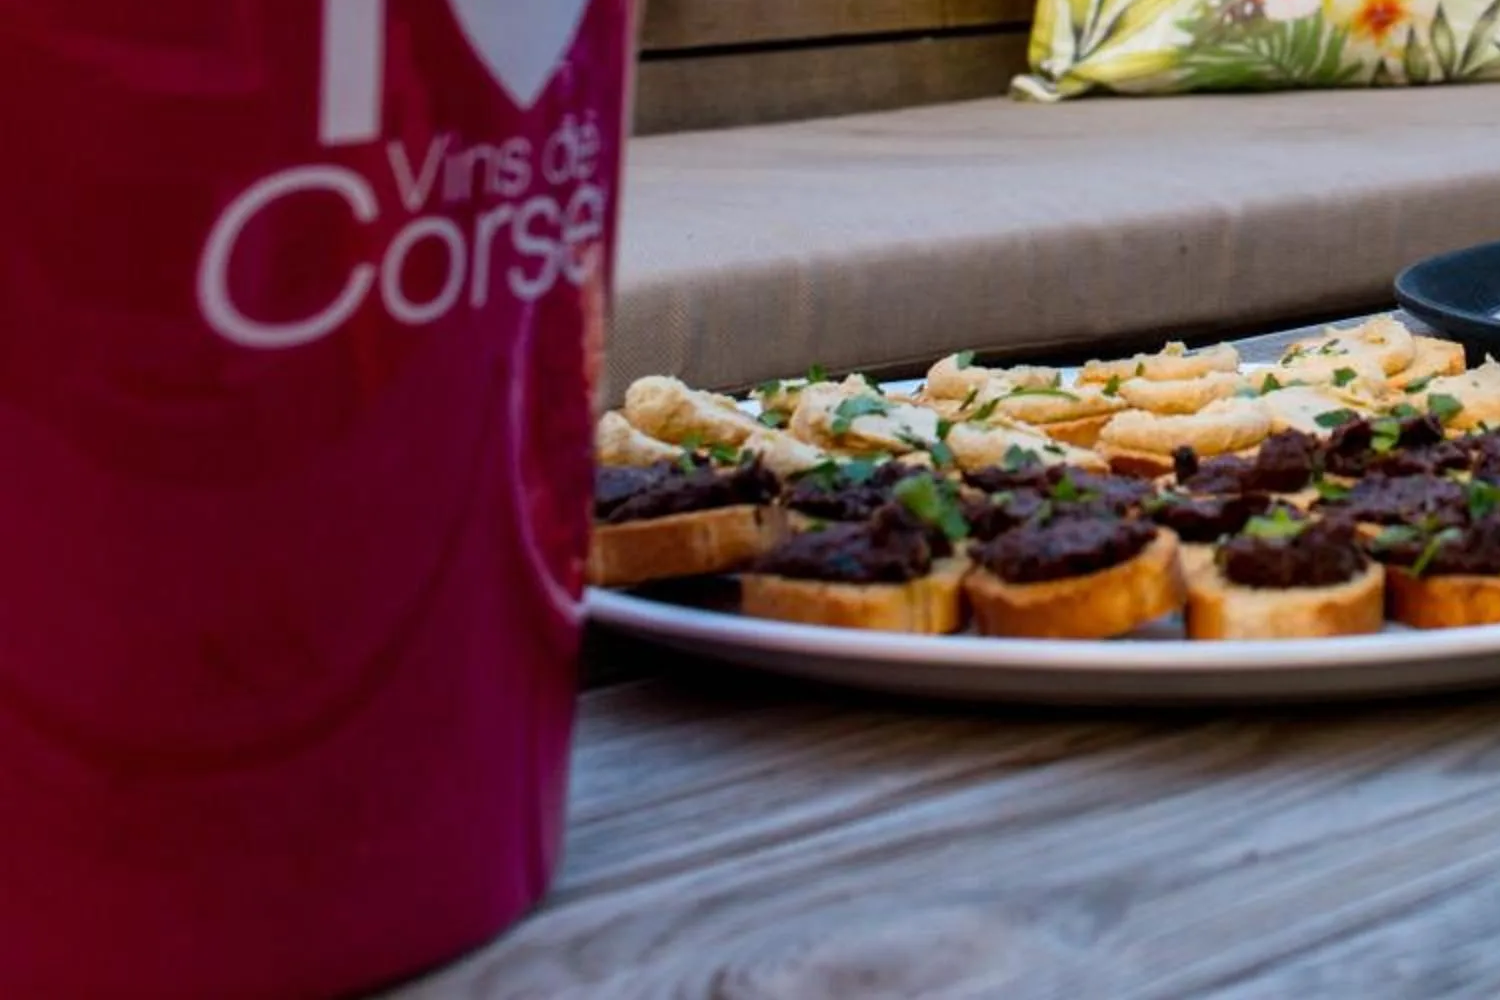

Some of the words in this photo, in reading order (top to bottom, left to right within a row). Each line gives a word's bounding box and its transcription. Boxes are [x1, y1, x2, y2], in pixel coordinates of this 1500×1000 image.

[386, 132, 533, 212] Vins
[541, 110, 602, 184] de
[197, 163, 608, 349] Corse
